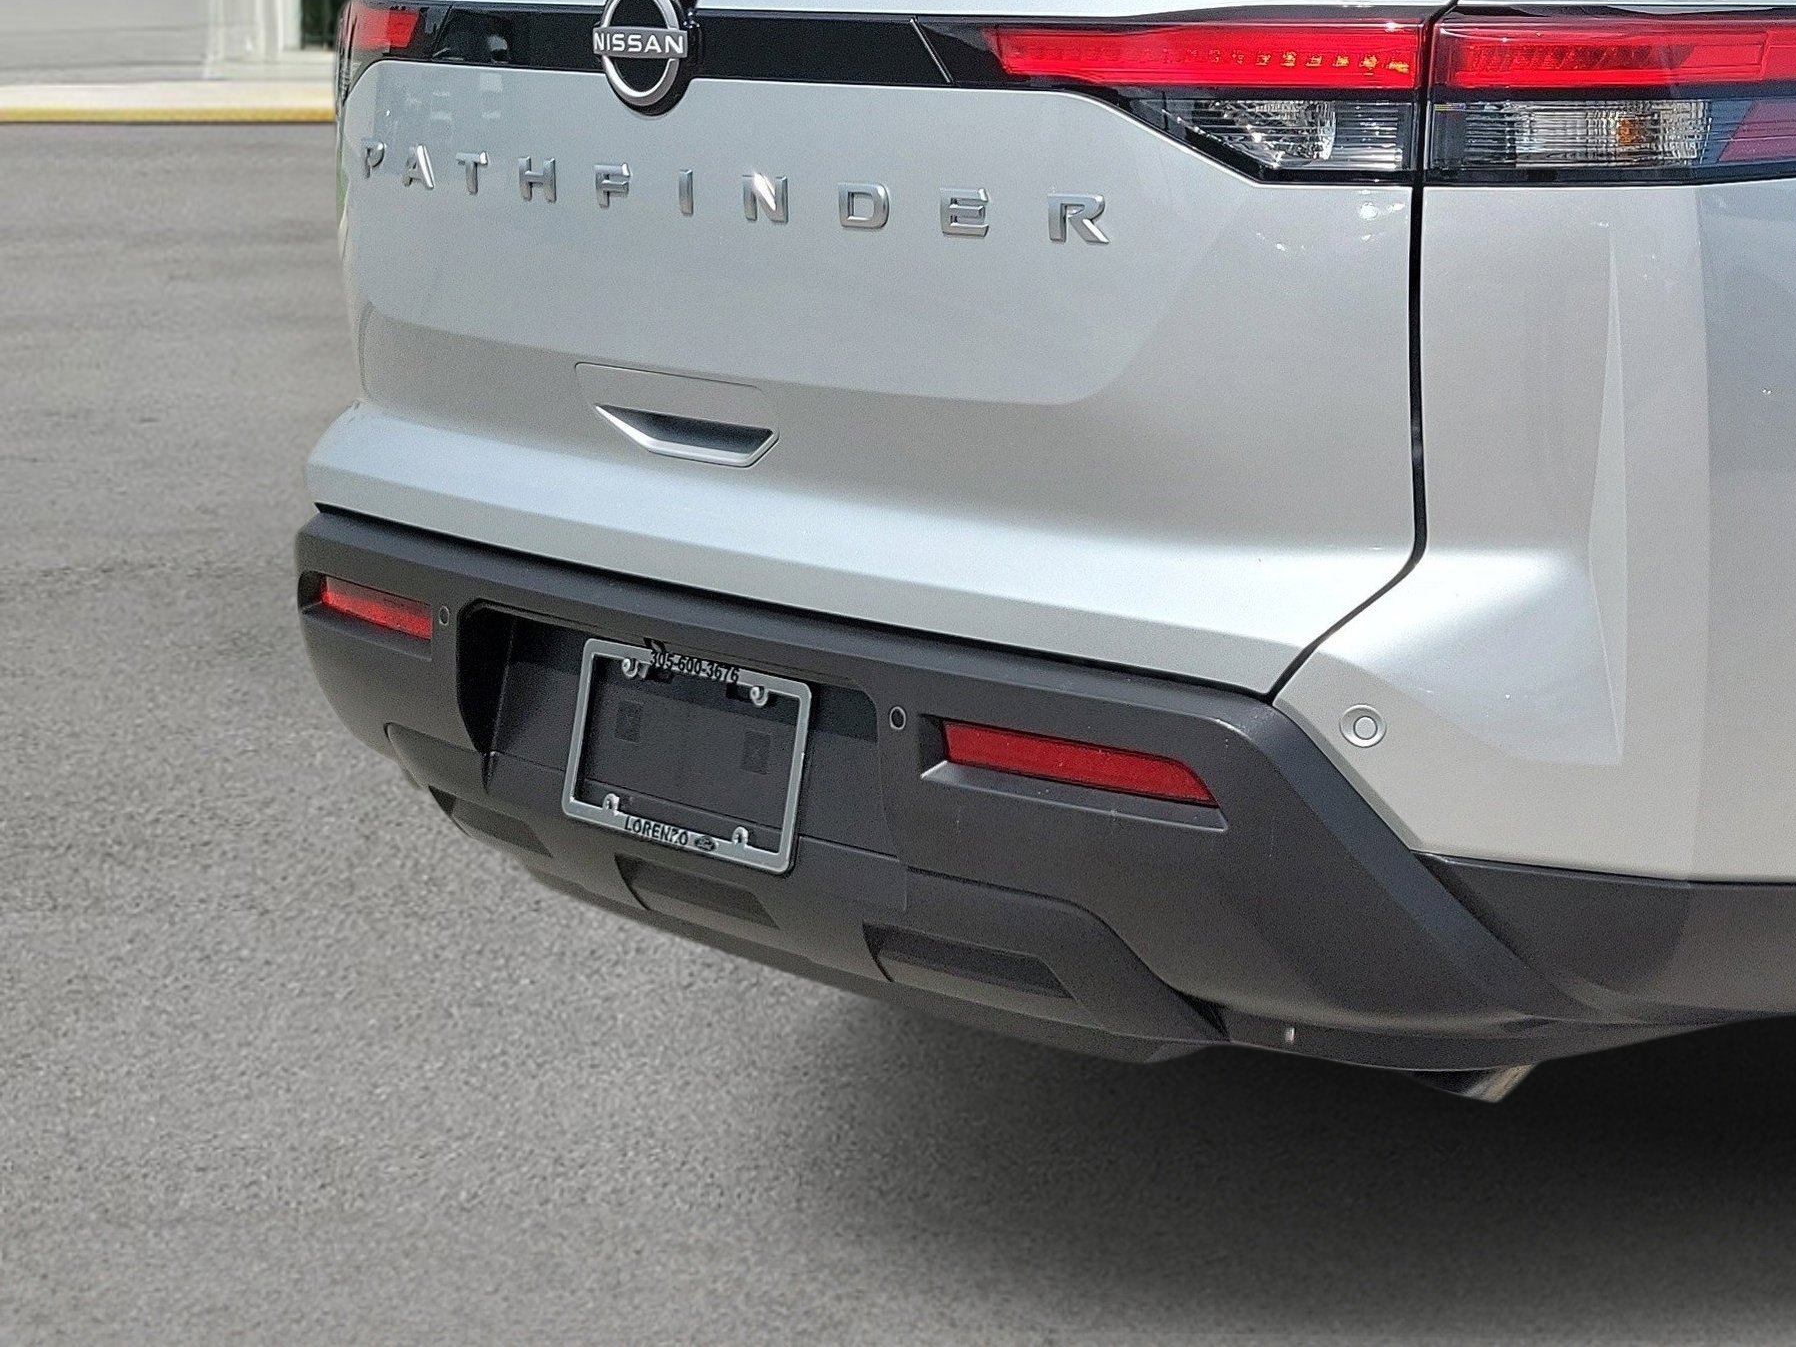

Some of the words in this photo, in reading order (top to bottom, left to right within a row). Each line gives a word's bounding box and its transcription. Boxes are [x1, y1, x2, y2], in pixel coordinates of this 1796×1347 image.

[593, 32, 684, 54] NISSAN
[360, 137, 1111, 245] PATHFINDER
[650, 651, 740, 684] 305-600-3676
[624, 816, 688, 846] LORENZO
